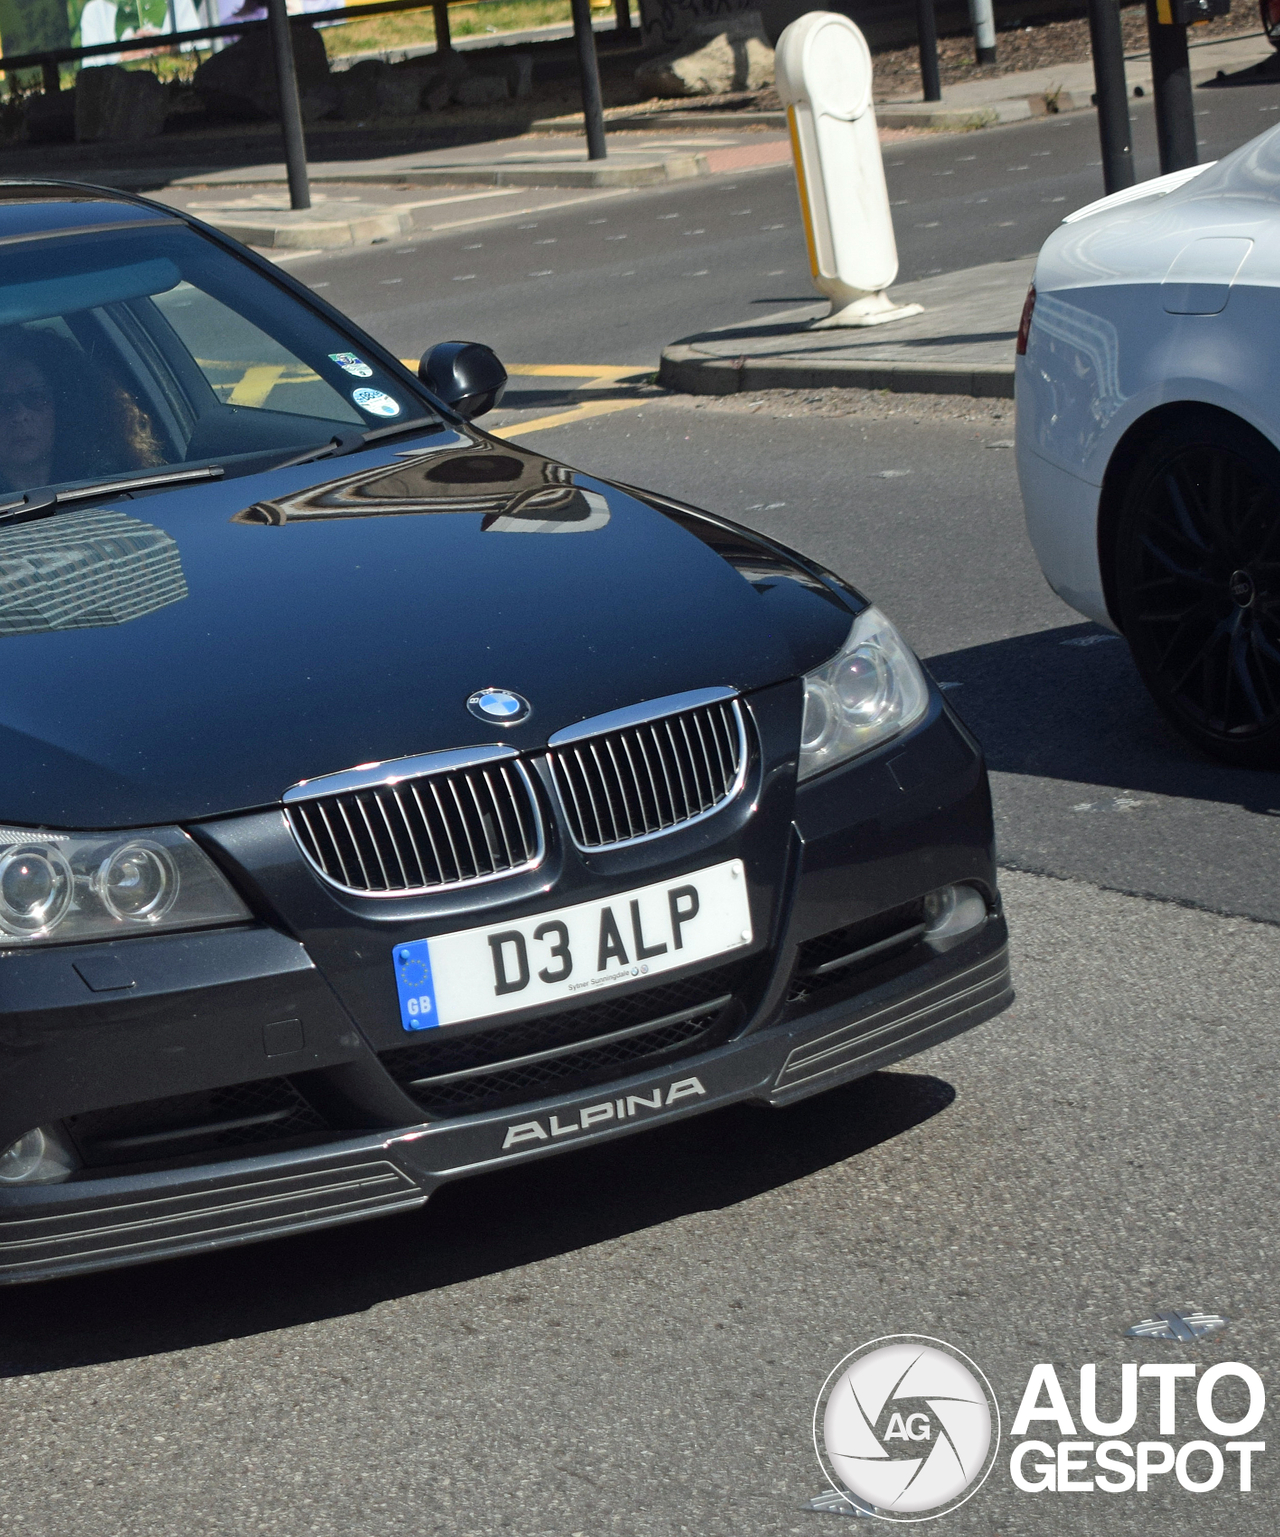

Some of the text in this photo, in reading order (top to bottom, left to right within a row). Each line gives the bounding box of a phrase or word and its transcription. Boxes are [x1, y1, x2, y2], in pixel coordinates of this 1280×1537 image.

[487, 883, 700, 996] D3 ALP
[407, 995, 431, 1015] GB
[502, 1076, 706, 1149] ALPINA
